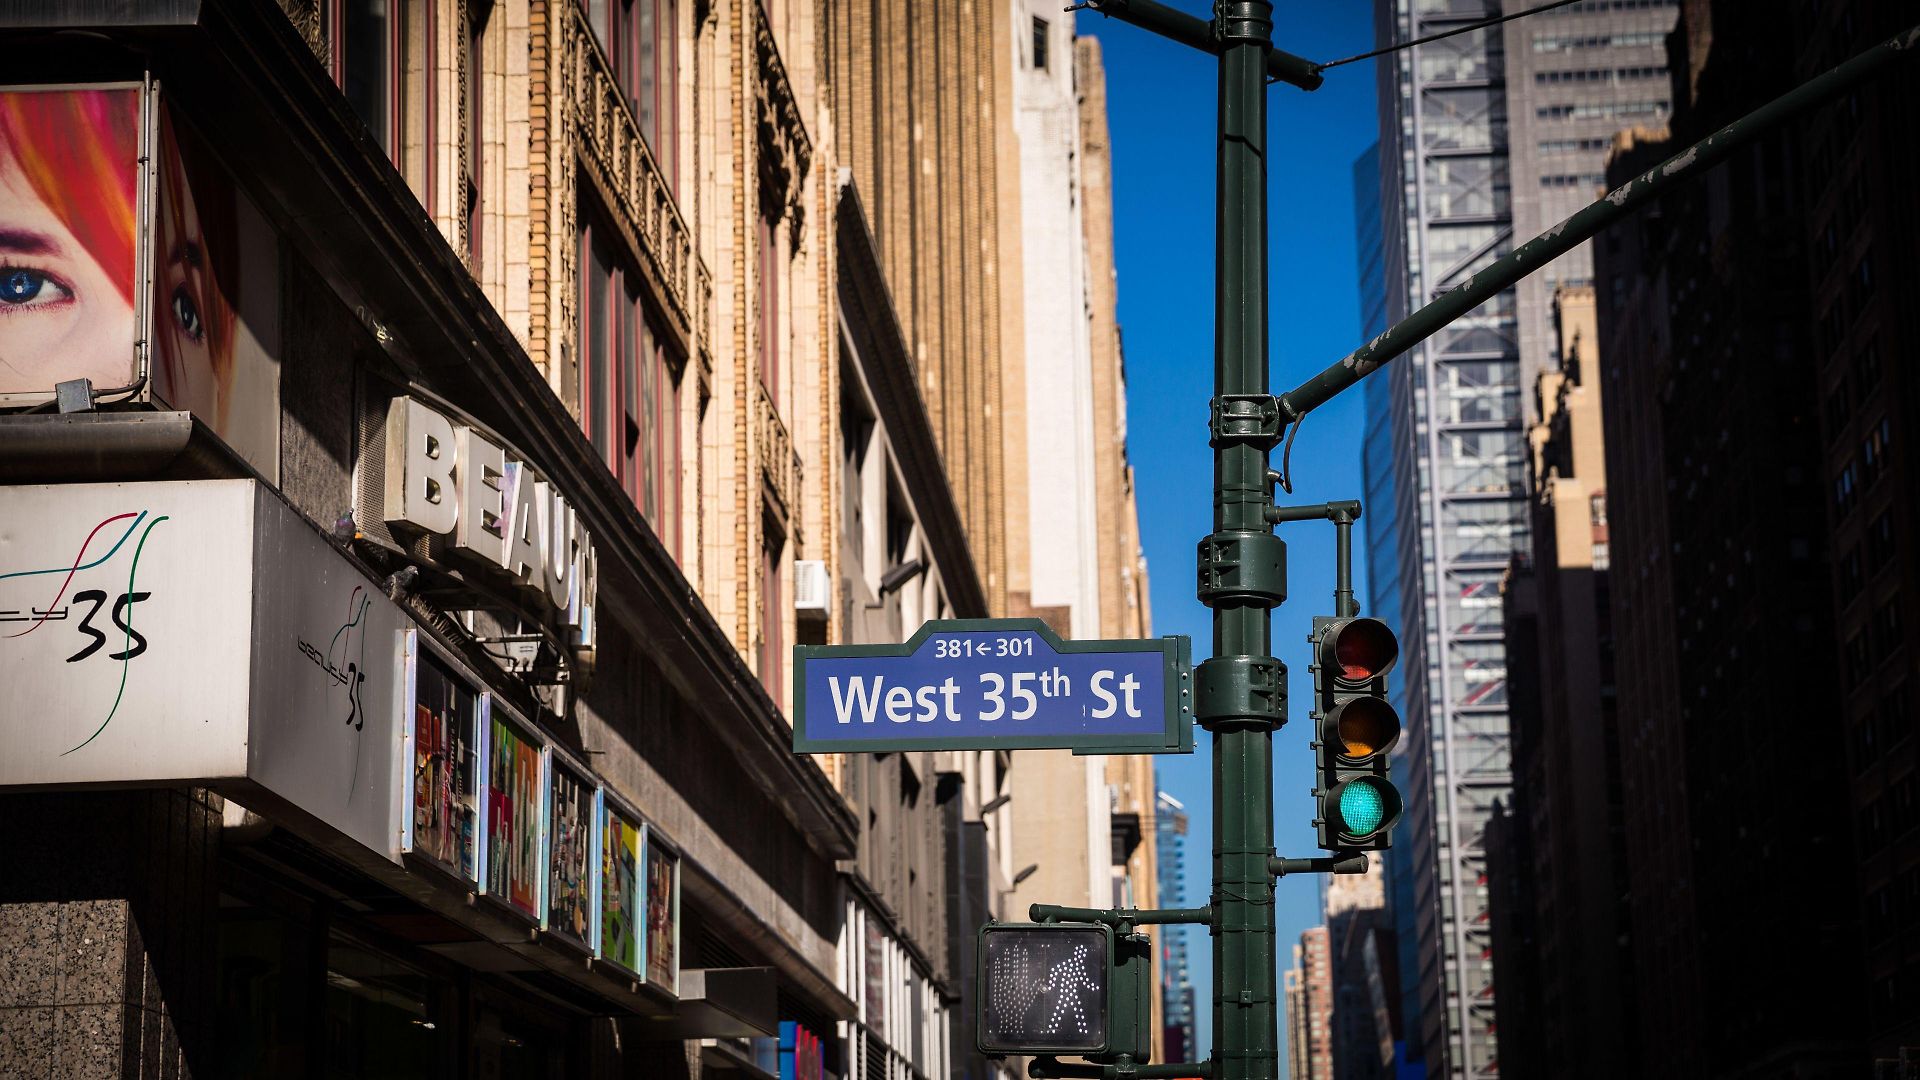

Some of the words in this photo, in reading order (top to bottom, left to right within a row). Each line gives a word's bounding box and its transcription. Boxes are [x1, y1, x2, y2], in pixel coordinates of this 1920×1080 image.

[66, 589, 151, 663] 35
[935, 638, 972, 658] 381
[996, 637, 1033, 657] 301
[828, 675, 961, 724] West
[978, 666, 1071, 722] 35th
[1089, 670, 1142, 720] St
